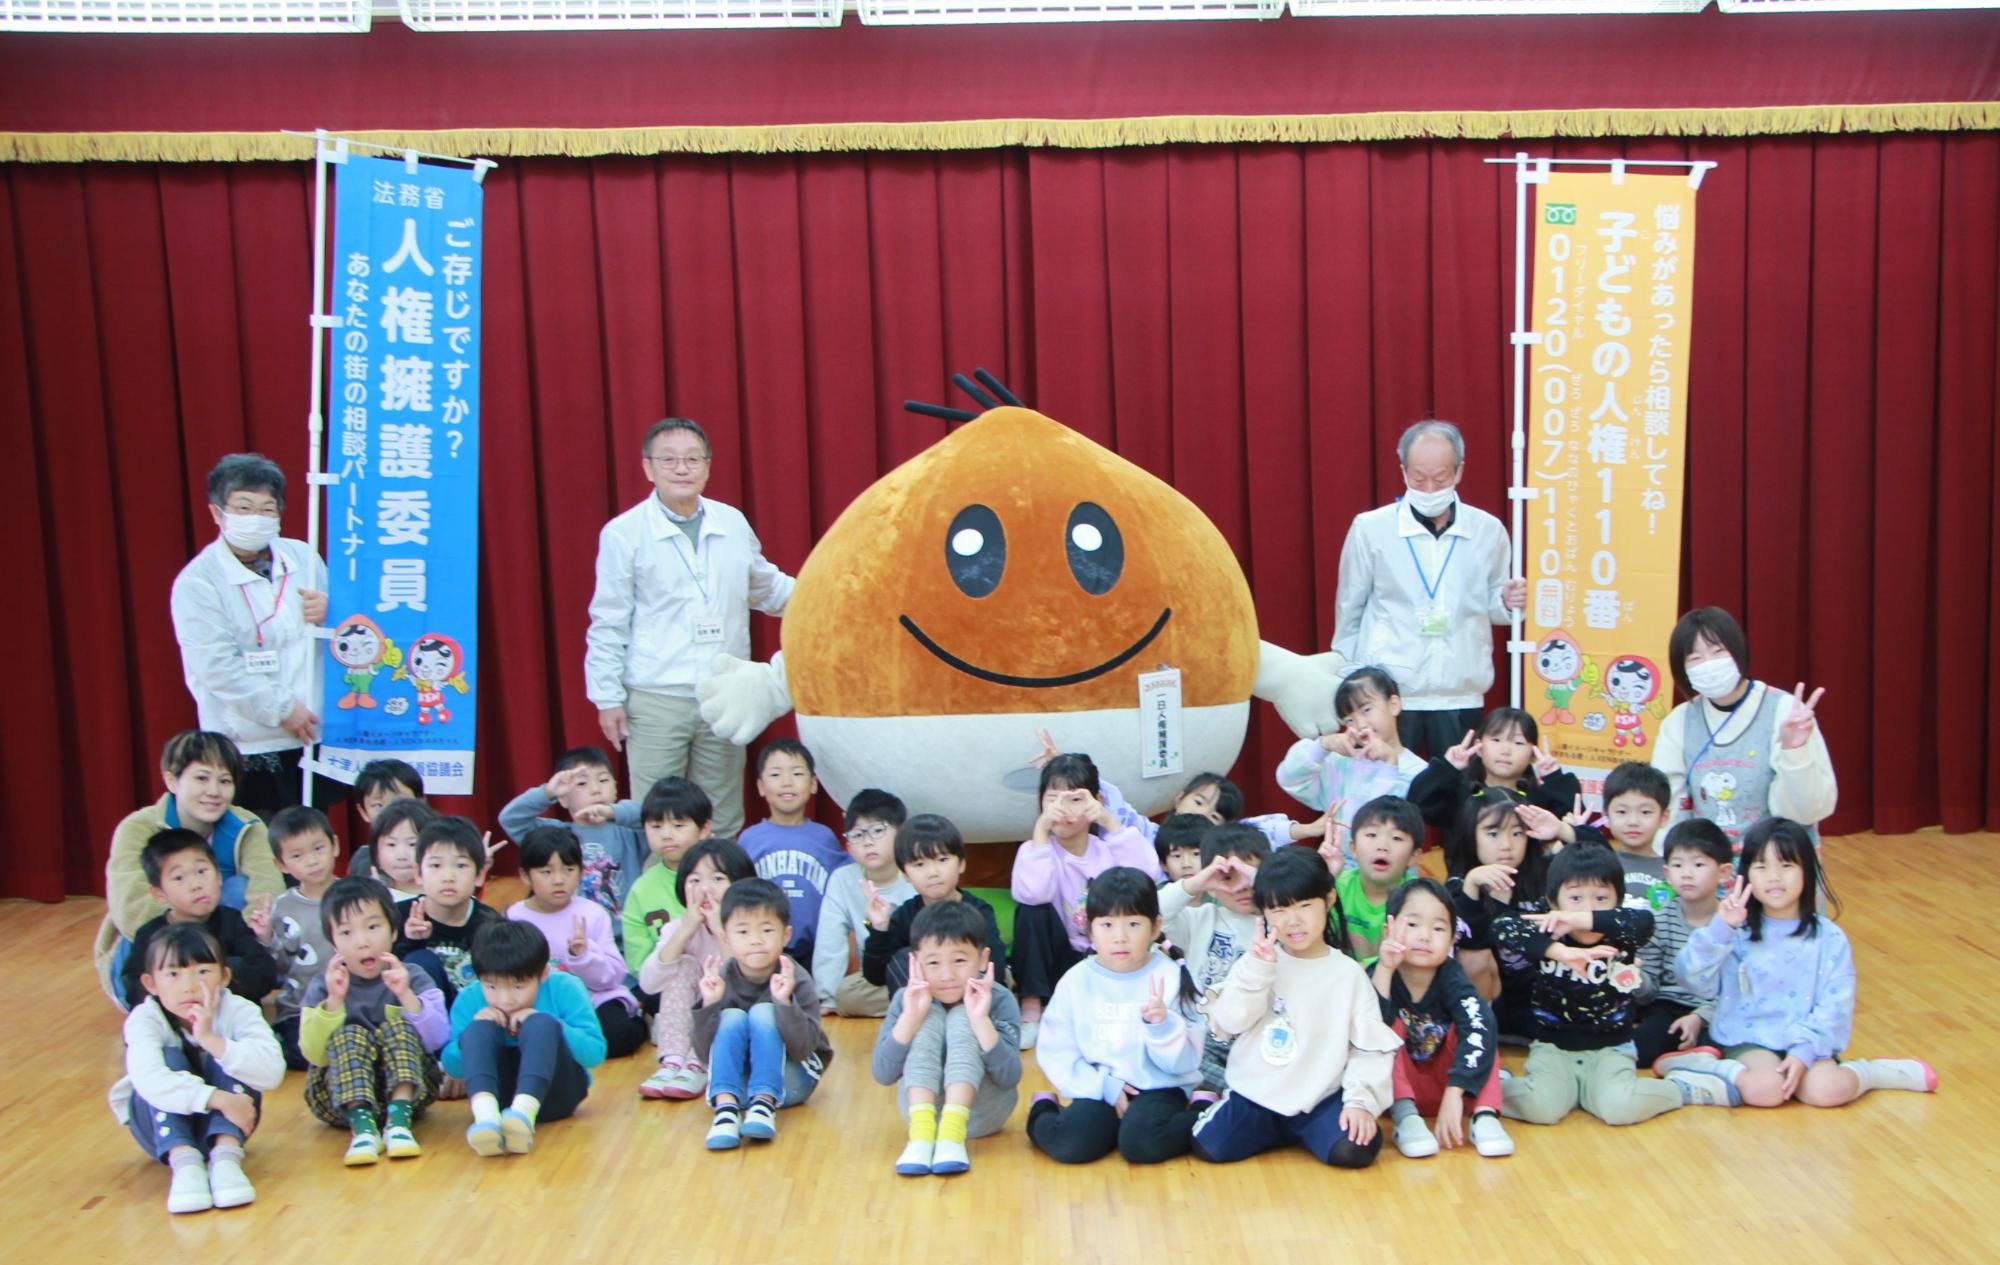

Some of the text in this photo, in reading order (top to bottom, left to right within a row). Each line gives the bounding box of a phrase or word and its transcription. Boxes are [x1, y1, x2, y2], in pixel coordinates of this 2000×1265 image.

[373, 180, 445, 209] 法務省
[340, 252, 370, 582] あなたの街の相談パートナー
[375, 218, 434, 613] 人権擁護委員
[1583, 211, 1638, 629] 子どもの人権110番
[1641, 204, 1680, 535] 悩みがあったら相談してね!
